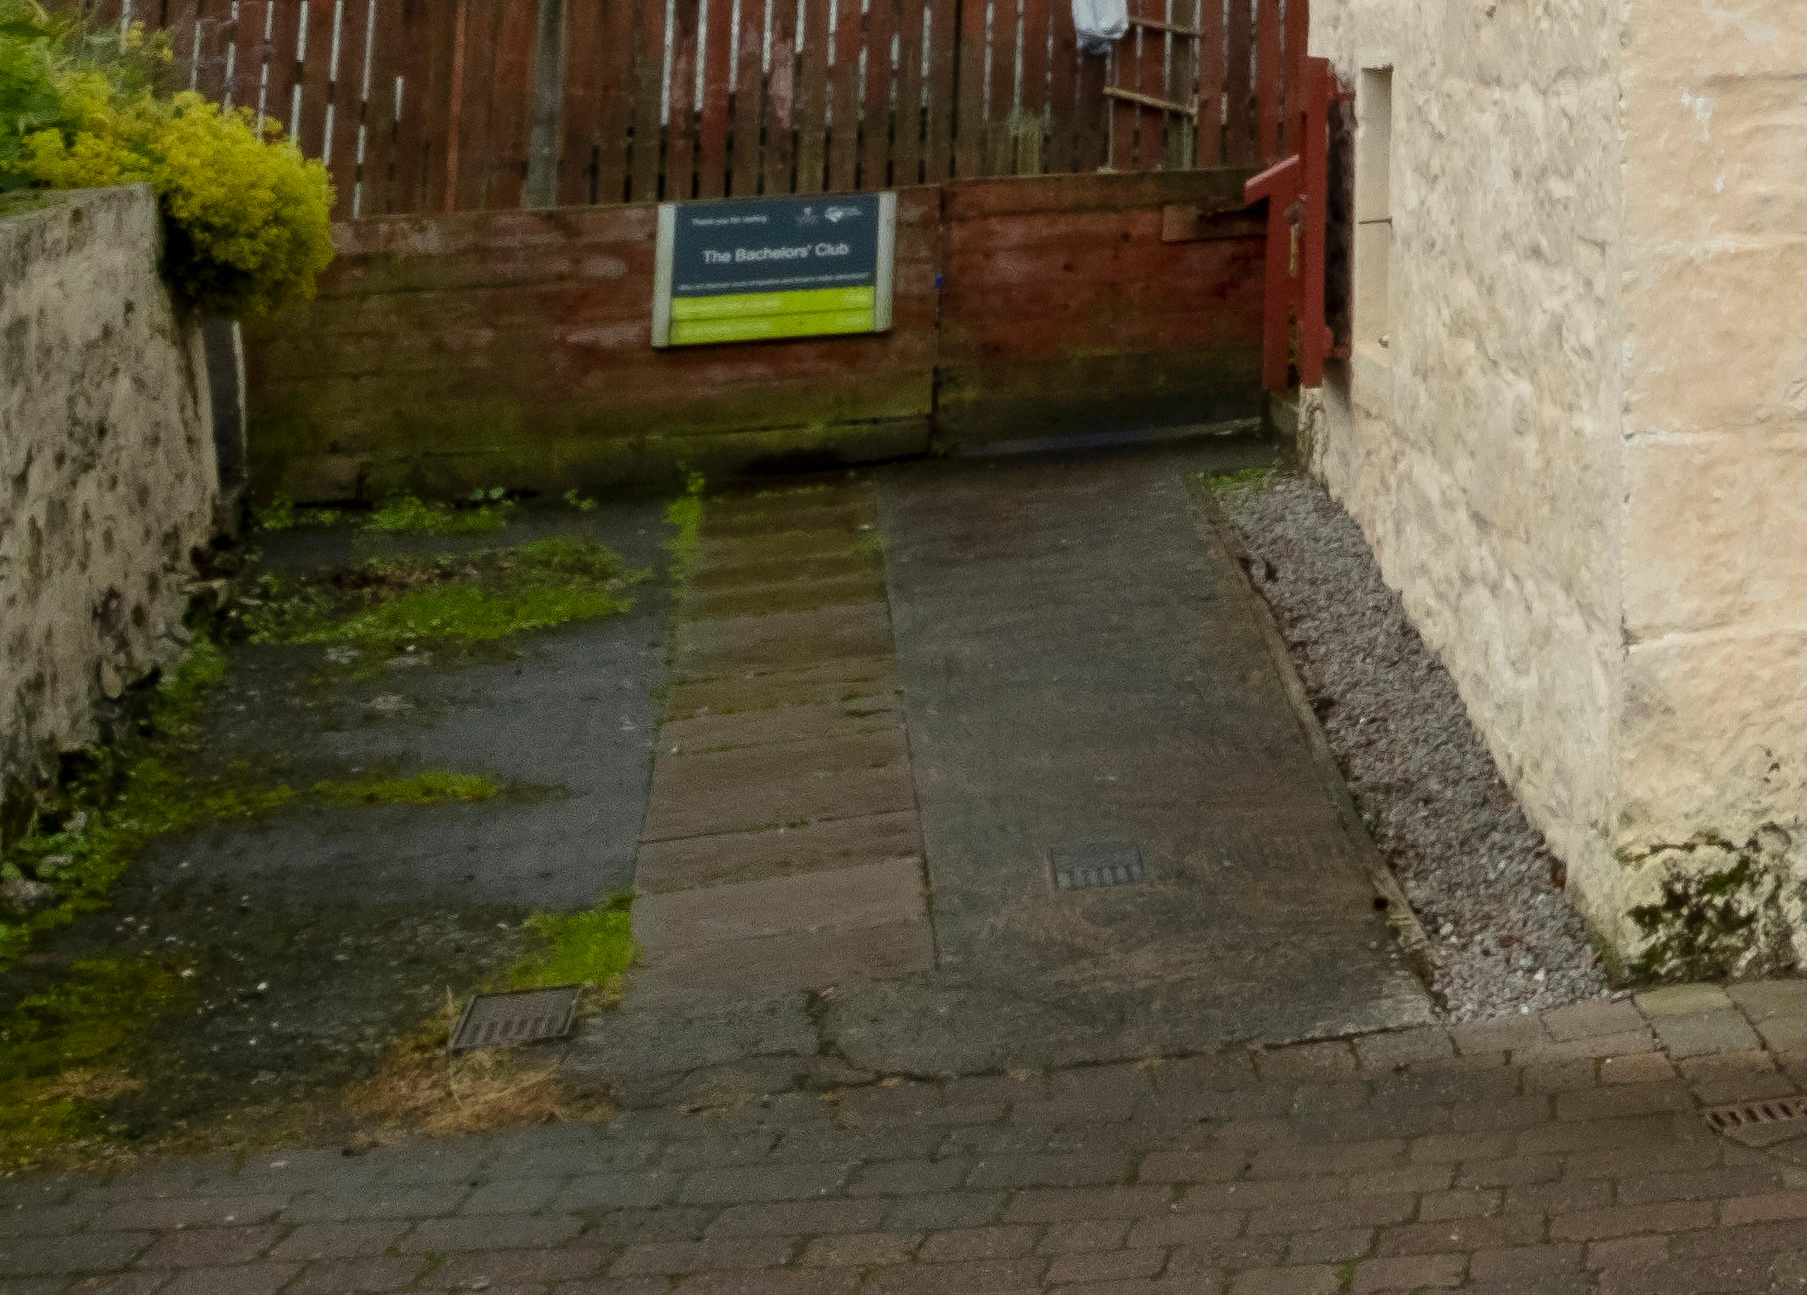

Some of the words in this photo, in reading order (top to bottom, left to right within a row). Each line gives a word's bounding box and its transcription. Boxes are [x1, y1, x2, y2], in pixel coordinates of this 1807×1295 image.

[703, 250, 731, 263] The
[735, 244, 811, 262] Bachelors'
[815, 243, 849, 257] Club
